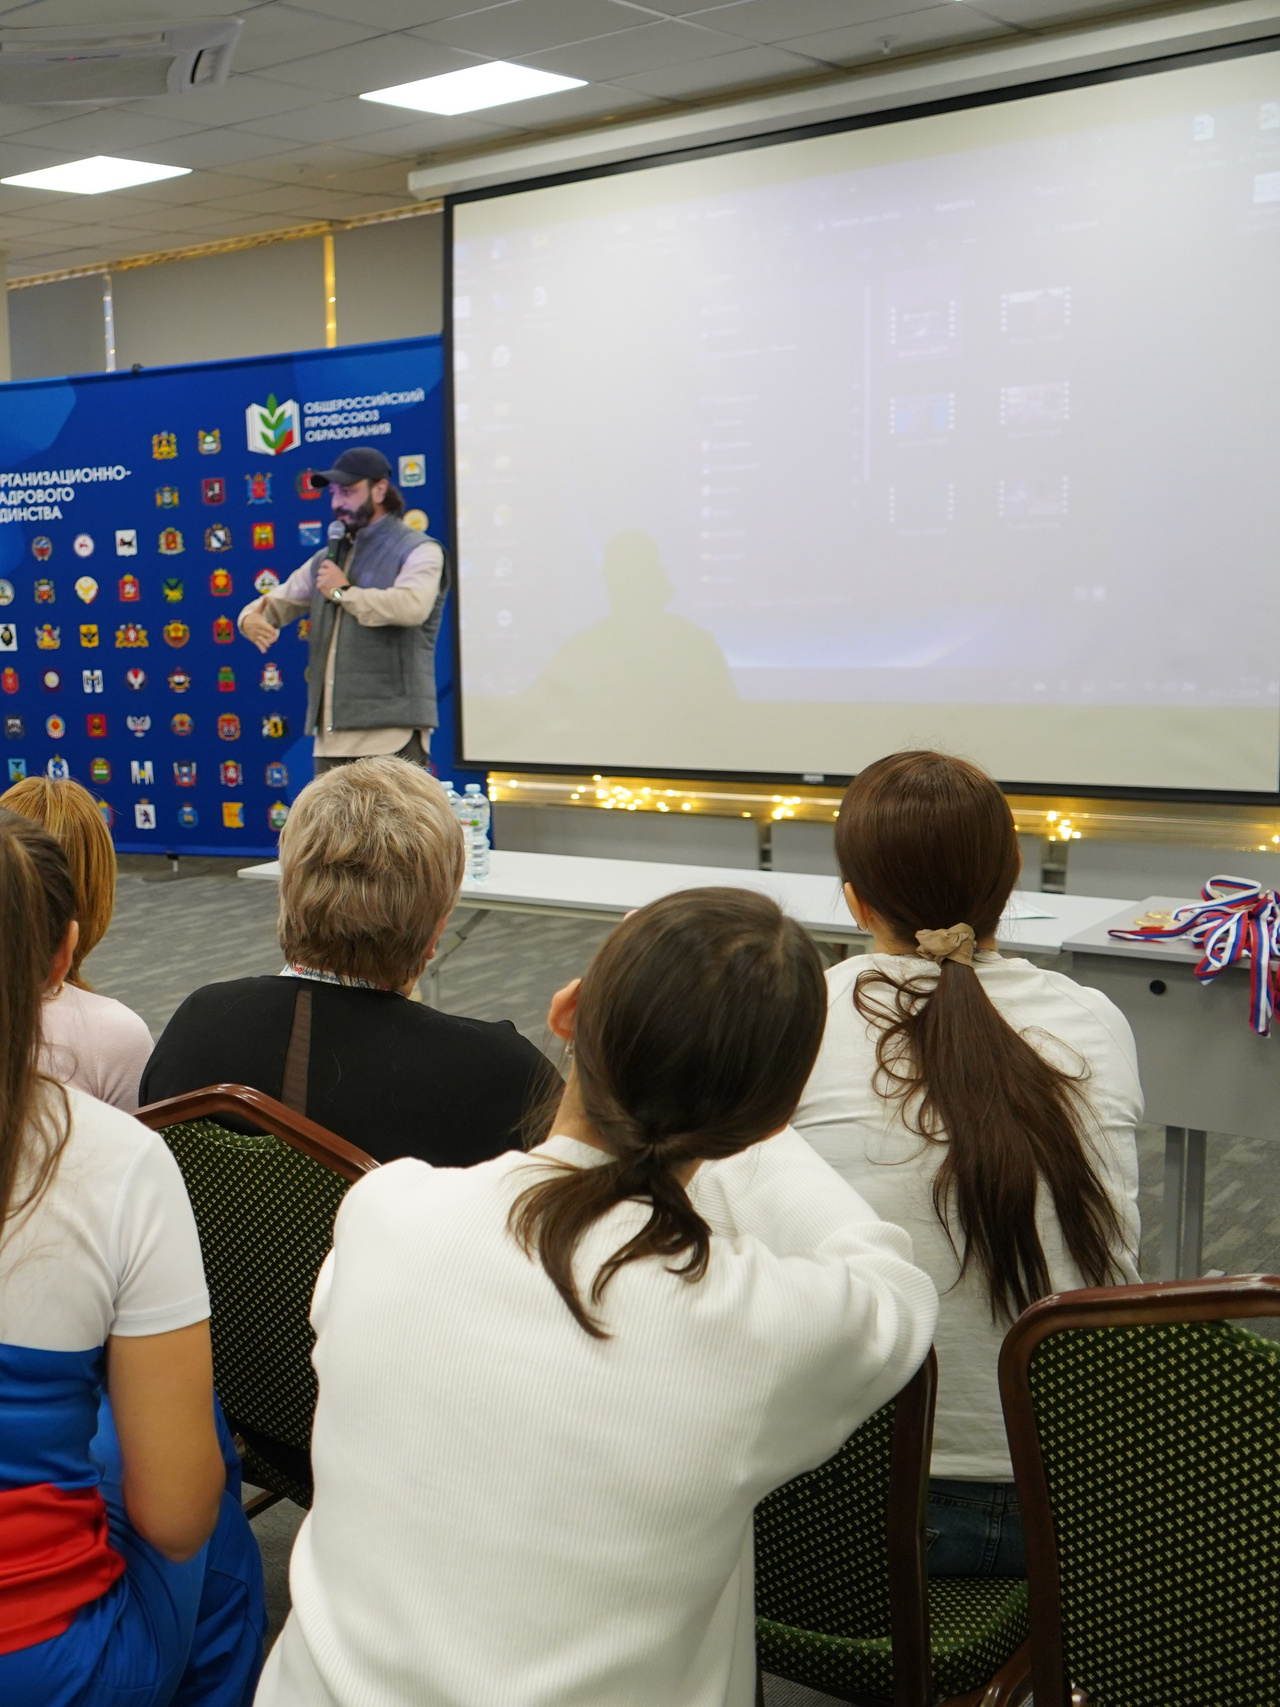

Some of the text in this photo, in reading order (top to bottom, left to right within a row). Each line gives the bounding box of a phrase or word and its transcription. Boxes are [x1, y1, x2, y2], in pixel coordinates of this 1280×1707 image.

[303, 387, 425, 414] ОБЩЕРОССИЙСКИЙ
[304, 409, 380, 428] ПРОФСОЮЗ
[305, 422, 391, 443] ОБРАЗОВАНИЯ
